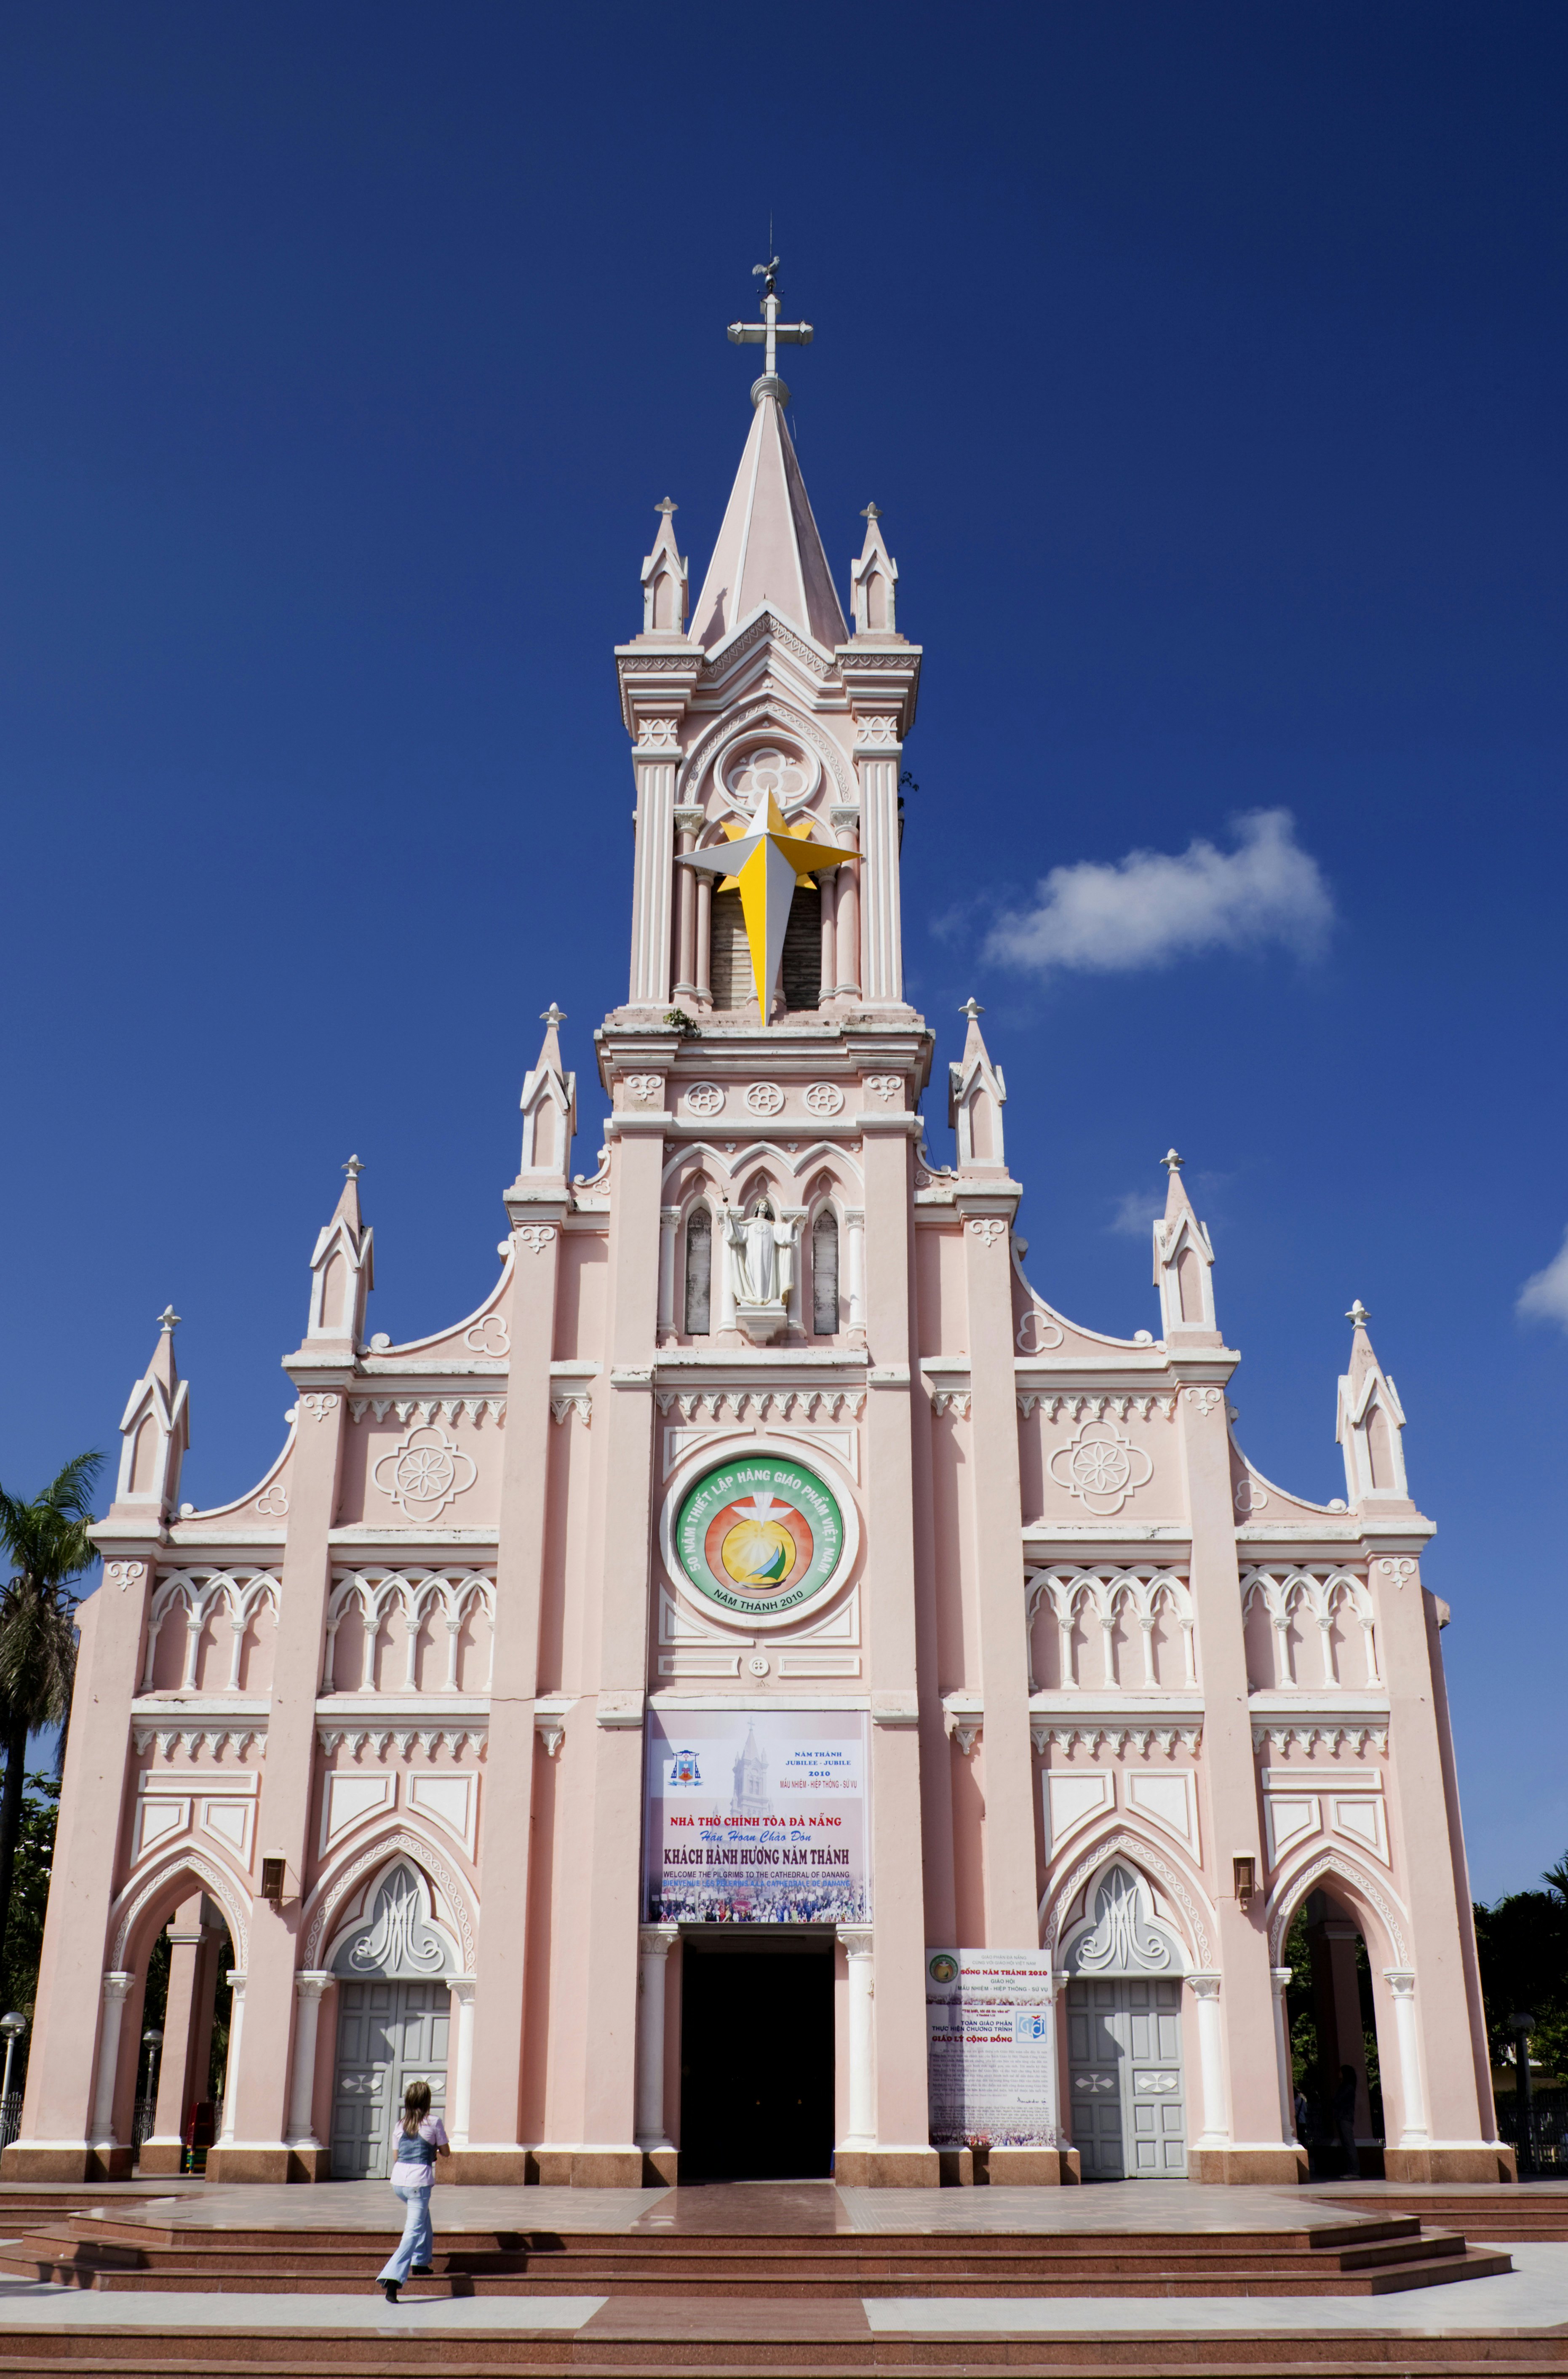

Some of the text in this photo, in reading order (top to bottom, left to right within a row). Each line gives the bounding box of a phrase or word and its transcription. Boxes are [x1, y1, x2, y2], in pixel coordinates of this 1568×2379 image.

[681, 1468, 838, 1574] 50 NĂM THIẾT LẬP HÀNG GIÁO PHẨM VIỆT NAM
[714, 1589, 804, 1611] NĂM THÁNH 2010
[792, 1778, 807, 1790] NHIỆM
[810, 1778, 822, 1790] HIỆP
[823, 1778, 839, 1789] THÔNG
[843, 1778, 850, 1789] SỨ
[851, 1781, 857, 1790] VỤ
[670, 1813, 842, 1826] NHÀ THỜ CHÍNH TÒA ĐÀ NẴNG
[700, 1830, 812, 1843] Hân Hoan Chào Đón
[664, 1844, 849, 1864] KHÁCH HÀNH HƯƠNG NĂM THÁNH
[966, 2035, 988, 2043] CỘNG
